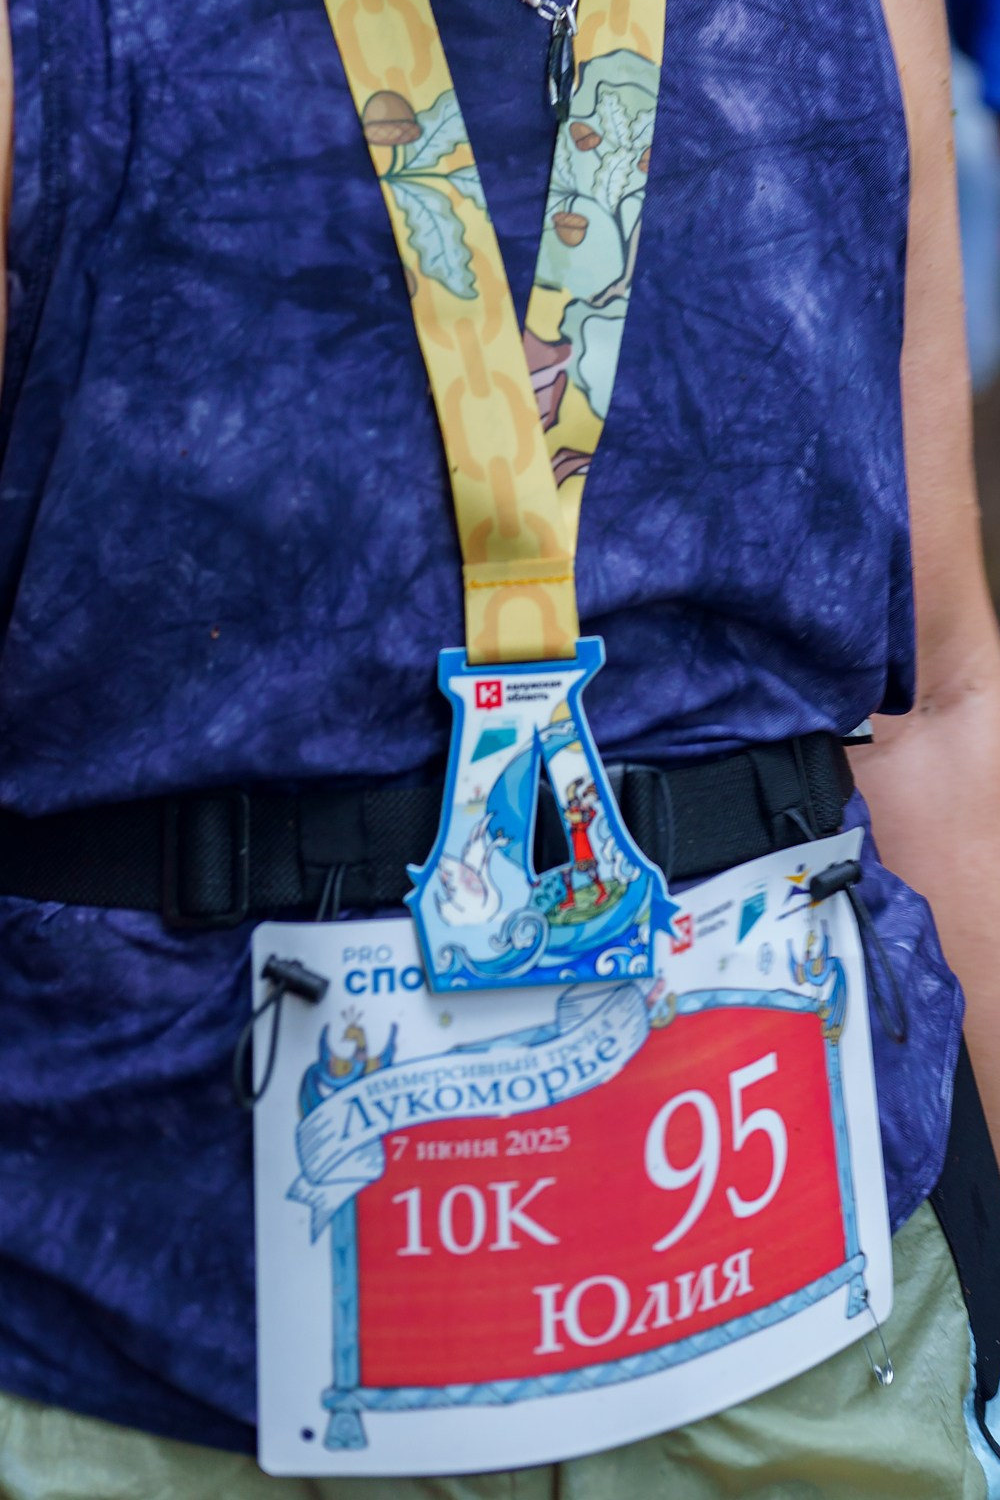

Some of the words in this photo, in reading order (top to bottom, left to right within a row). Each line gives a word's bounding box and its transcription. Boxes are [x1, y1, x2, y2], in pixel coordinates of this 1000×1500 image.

[342, 944, 394, 965] PRO
[338, 1035, 622, 1142] Лукоморье
[390, 1135, 410, 1161] 7
[416, 1137, 498, 1161] июня
[505, 1125, 571, 1156] 2025
[643, 1051, 788, 1252] 95
[533, 1248, 754, 1355] Юлия
